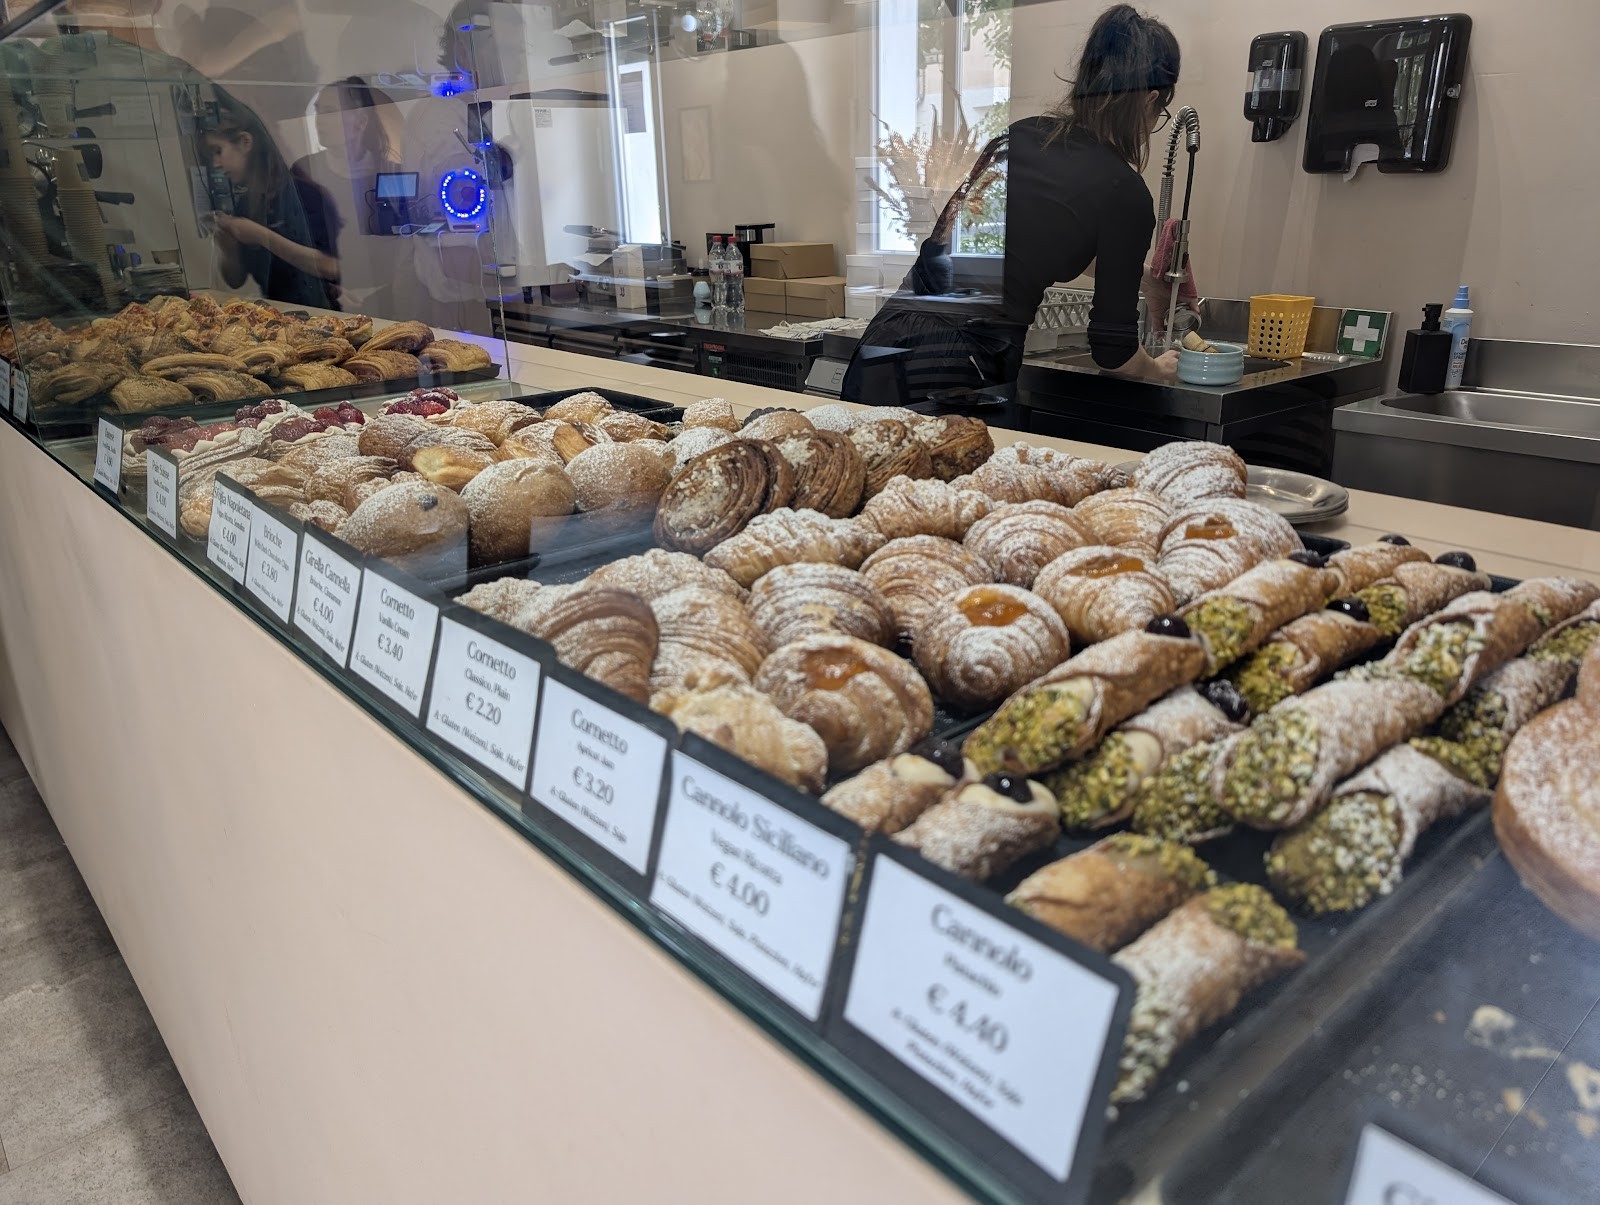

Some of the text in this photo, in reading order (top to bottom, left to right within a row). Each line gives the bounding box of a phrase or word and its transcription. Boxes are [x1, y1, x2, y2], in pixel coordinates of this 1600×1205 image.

[226, 493, 251, 523] Napoletana
[225, 528, 236, 547] 4.00
[263, 523, 282, 549] Brioche
[265, 562, 277, 584] 3.80
[305, 547, 351, 595] Girella Cannella
[318, 600, 334, 625] 4.00
[379, 586, 416, 621] Cornetto
[376, 631, 404, 662] € 3.40
[466, 638, 517, 681] Cornetto
[463, 666, 511, 702] Classico, Plain
[463, 689, 502, 727] € 2.20
[441, 712, 461, 733] Gluten
[505, 752, 524, 775] Hafer
[570, 706, 629, 757] Cornetto
[572, 764, 614, 807] € 3.20
[680, 773, 832, 882] Cannolo Siciliano
[708, 858, 770, 919] € 4.00
[929, 901, 1036, 986] Cannolo
[924, 979, 1010, 1058] € 4.40
